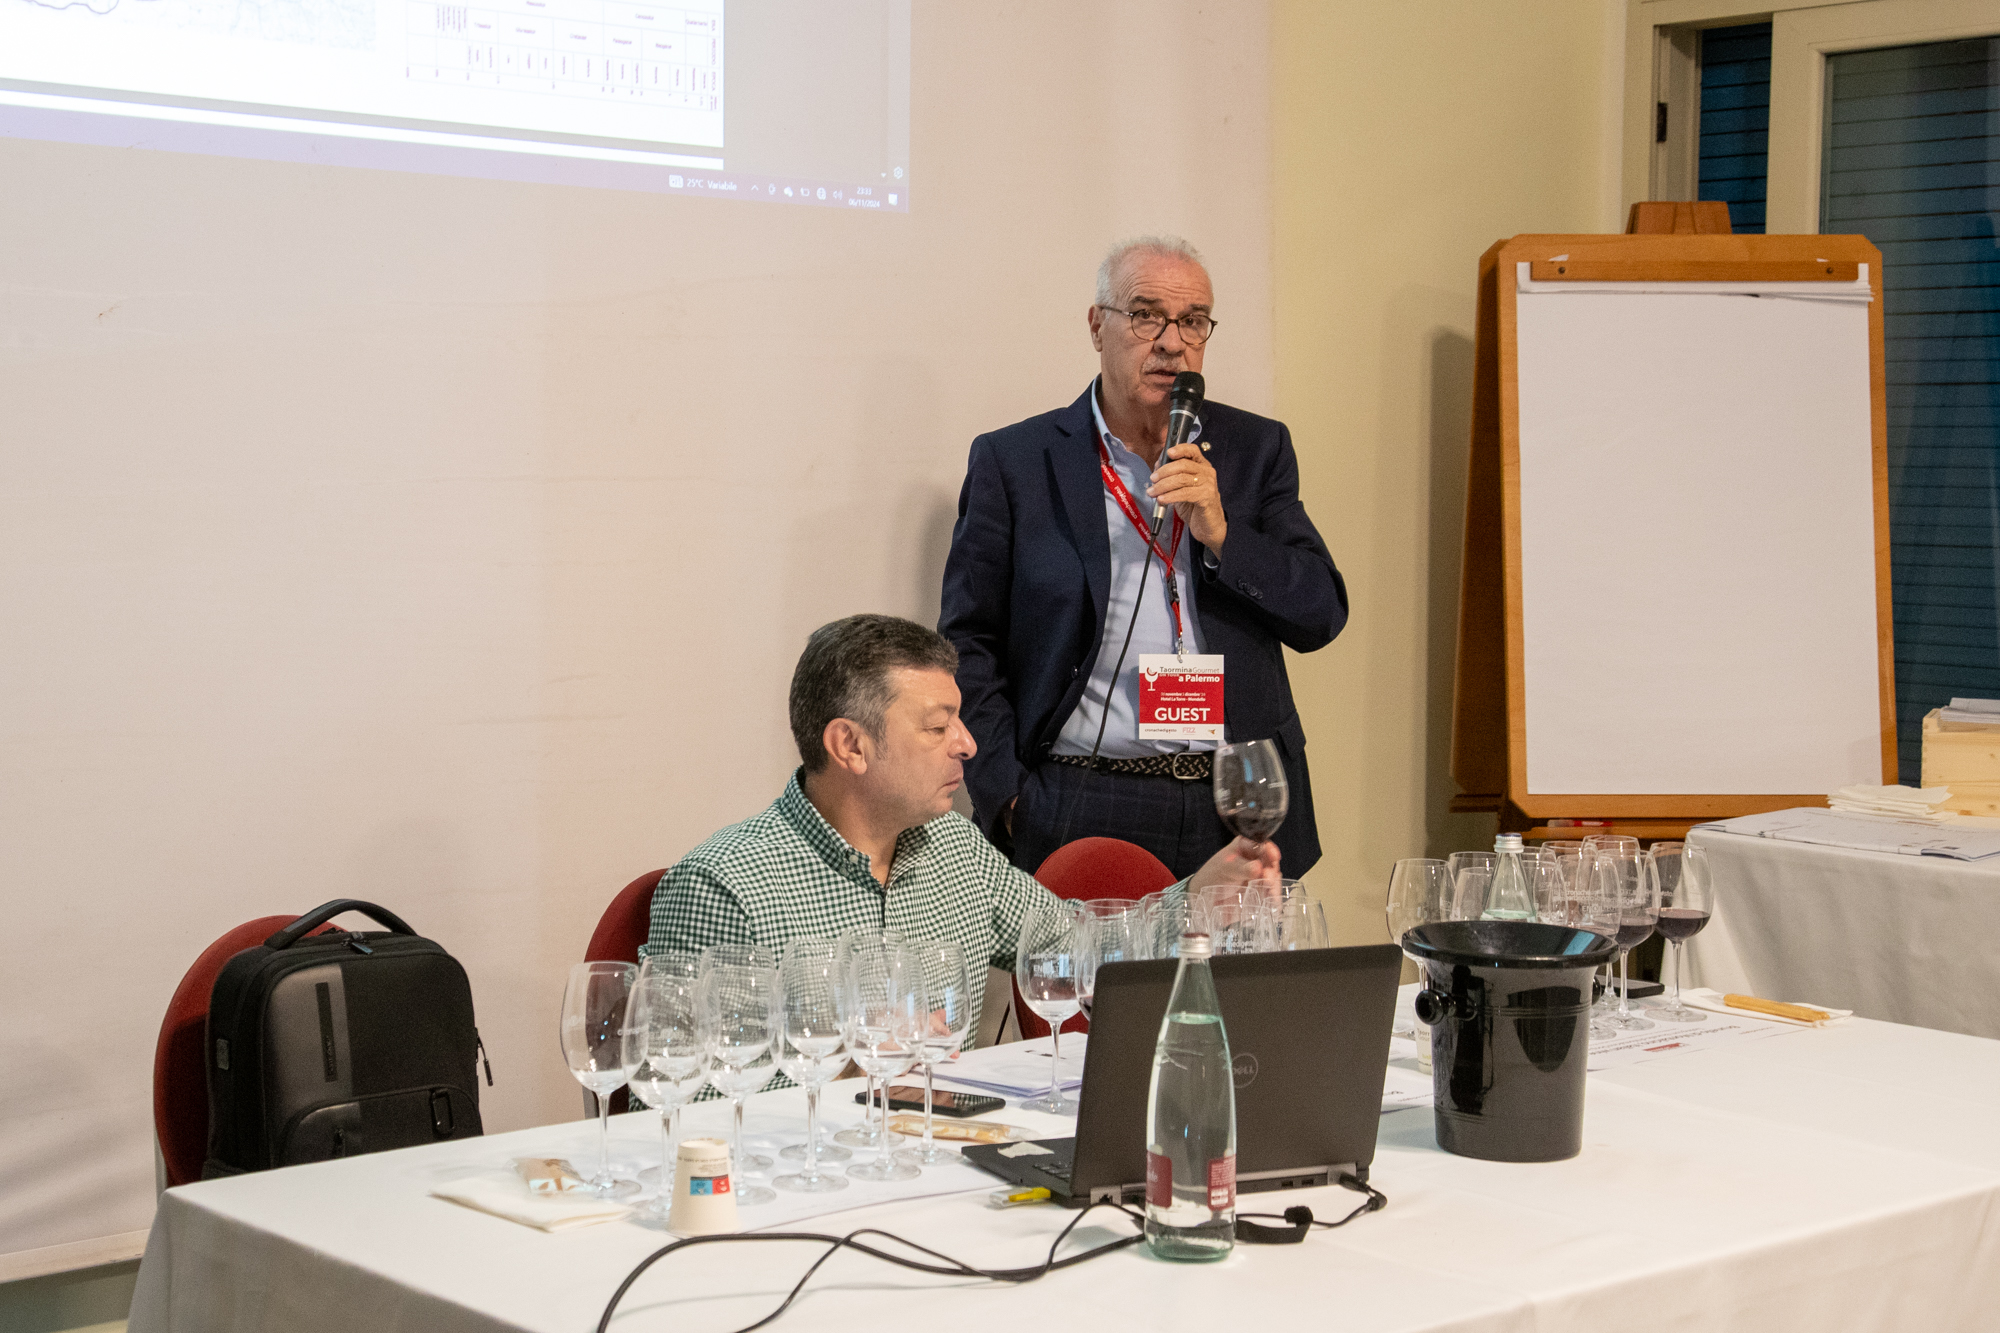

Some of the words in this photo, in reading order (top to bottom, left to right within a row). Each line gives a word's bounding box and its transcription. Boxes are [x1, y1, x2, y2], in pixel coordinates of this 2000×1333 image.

[707, 180, 738, 191] Variabile
[1185, 674, 1220, 682] Palermo
[1154, 707, 1211, 721] GUEST
